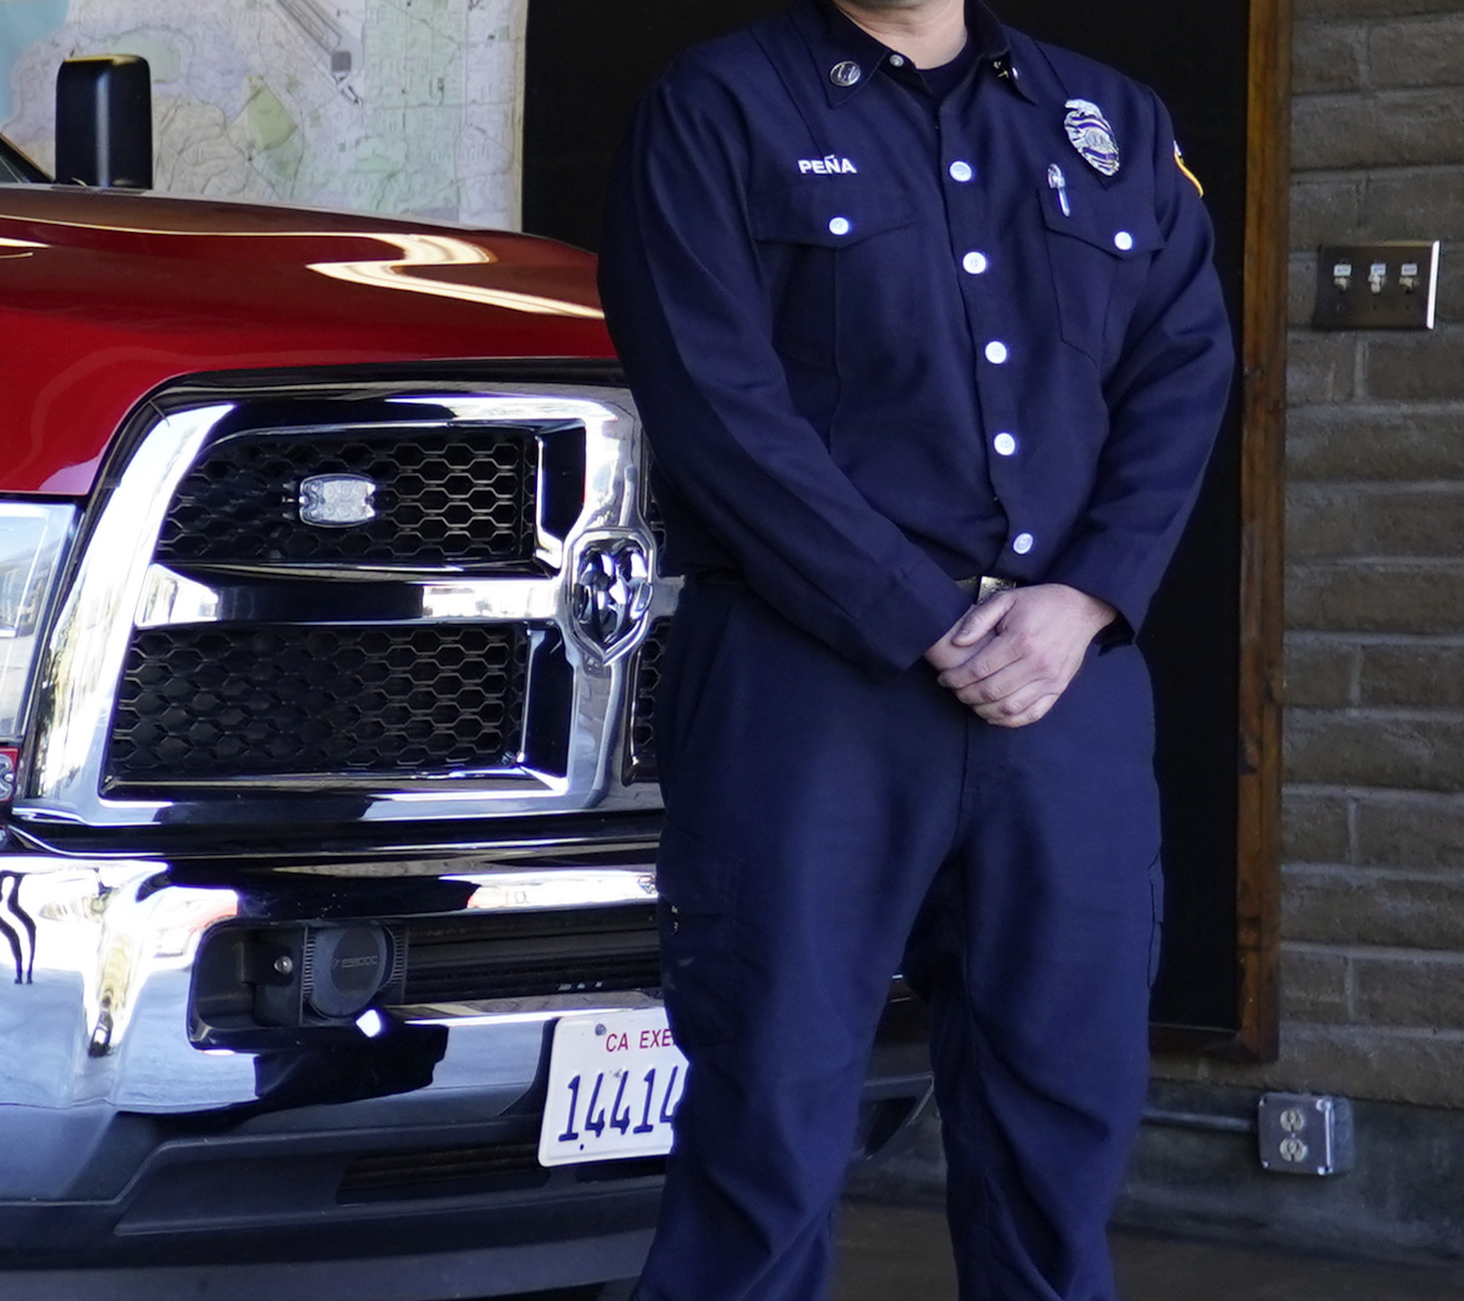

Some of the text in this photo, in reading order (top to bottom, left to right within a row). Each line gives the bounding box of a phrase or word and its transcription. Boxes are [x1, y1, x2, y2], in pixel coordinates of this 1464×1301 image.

[797, 154, 858, 174] PEÑA
[606, 1029, 676, 1052] CA EXE
